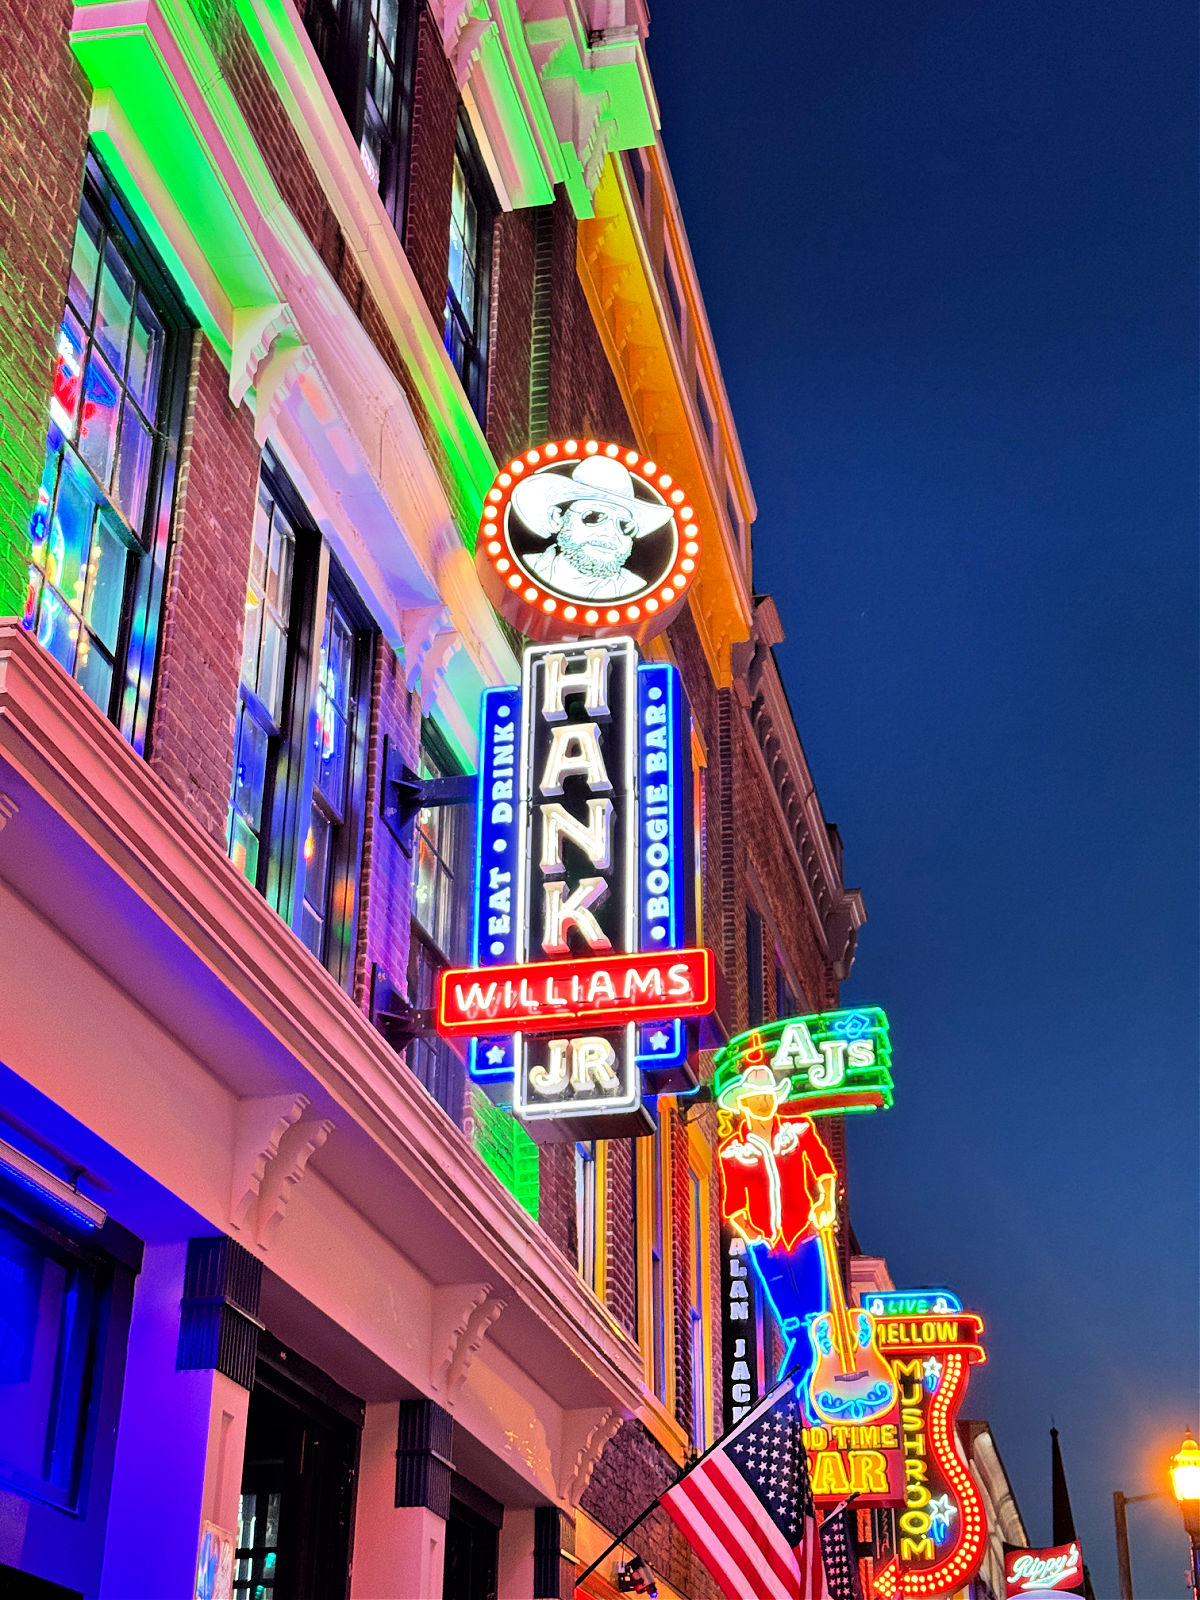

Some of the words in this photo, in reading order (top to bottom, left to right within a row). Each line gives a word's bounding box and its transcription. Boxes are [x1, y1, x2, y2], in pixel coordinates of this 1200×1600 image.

[491, 722, 514, 824] DRINK
[645, 703, 667, 774] BAR
[540, 648, 613, 953] HANK
[645, 784, 670, 919] BOOGIE
[488, 867, 511, 935] EAT
[455, 964, 690, 1012] WILLIAMS
[529, 1036, 620, 1095] JR
[729, 1237, 749, 1320] ALAN
[887, 1299, 928, 1314] LIVE
[832, 1424, 898, 1450] TIME
[891, 1358, 935, 1561] MUSHROOM
[807, 1450, 889, 1494] AR
